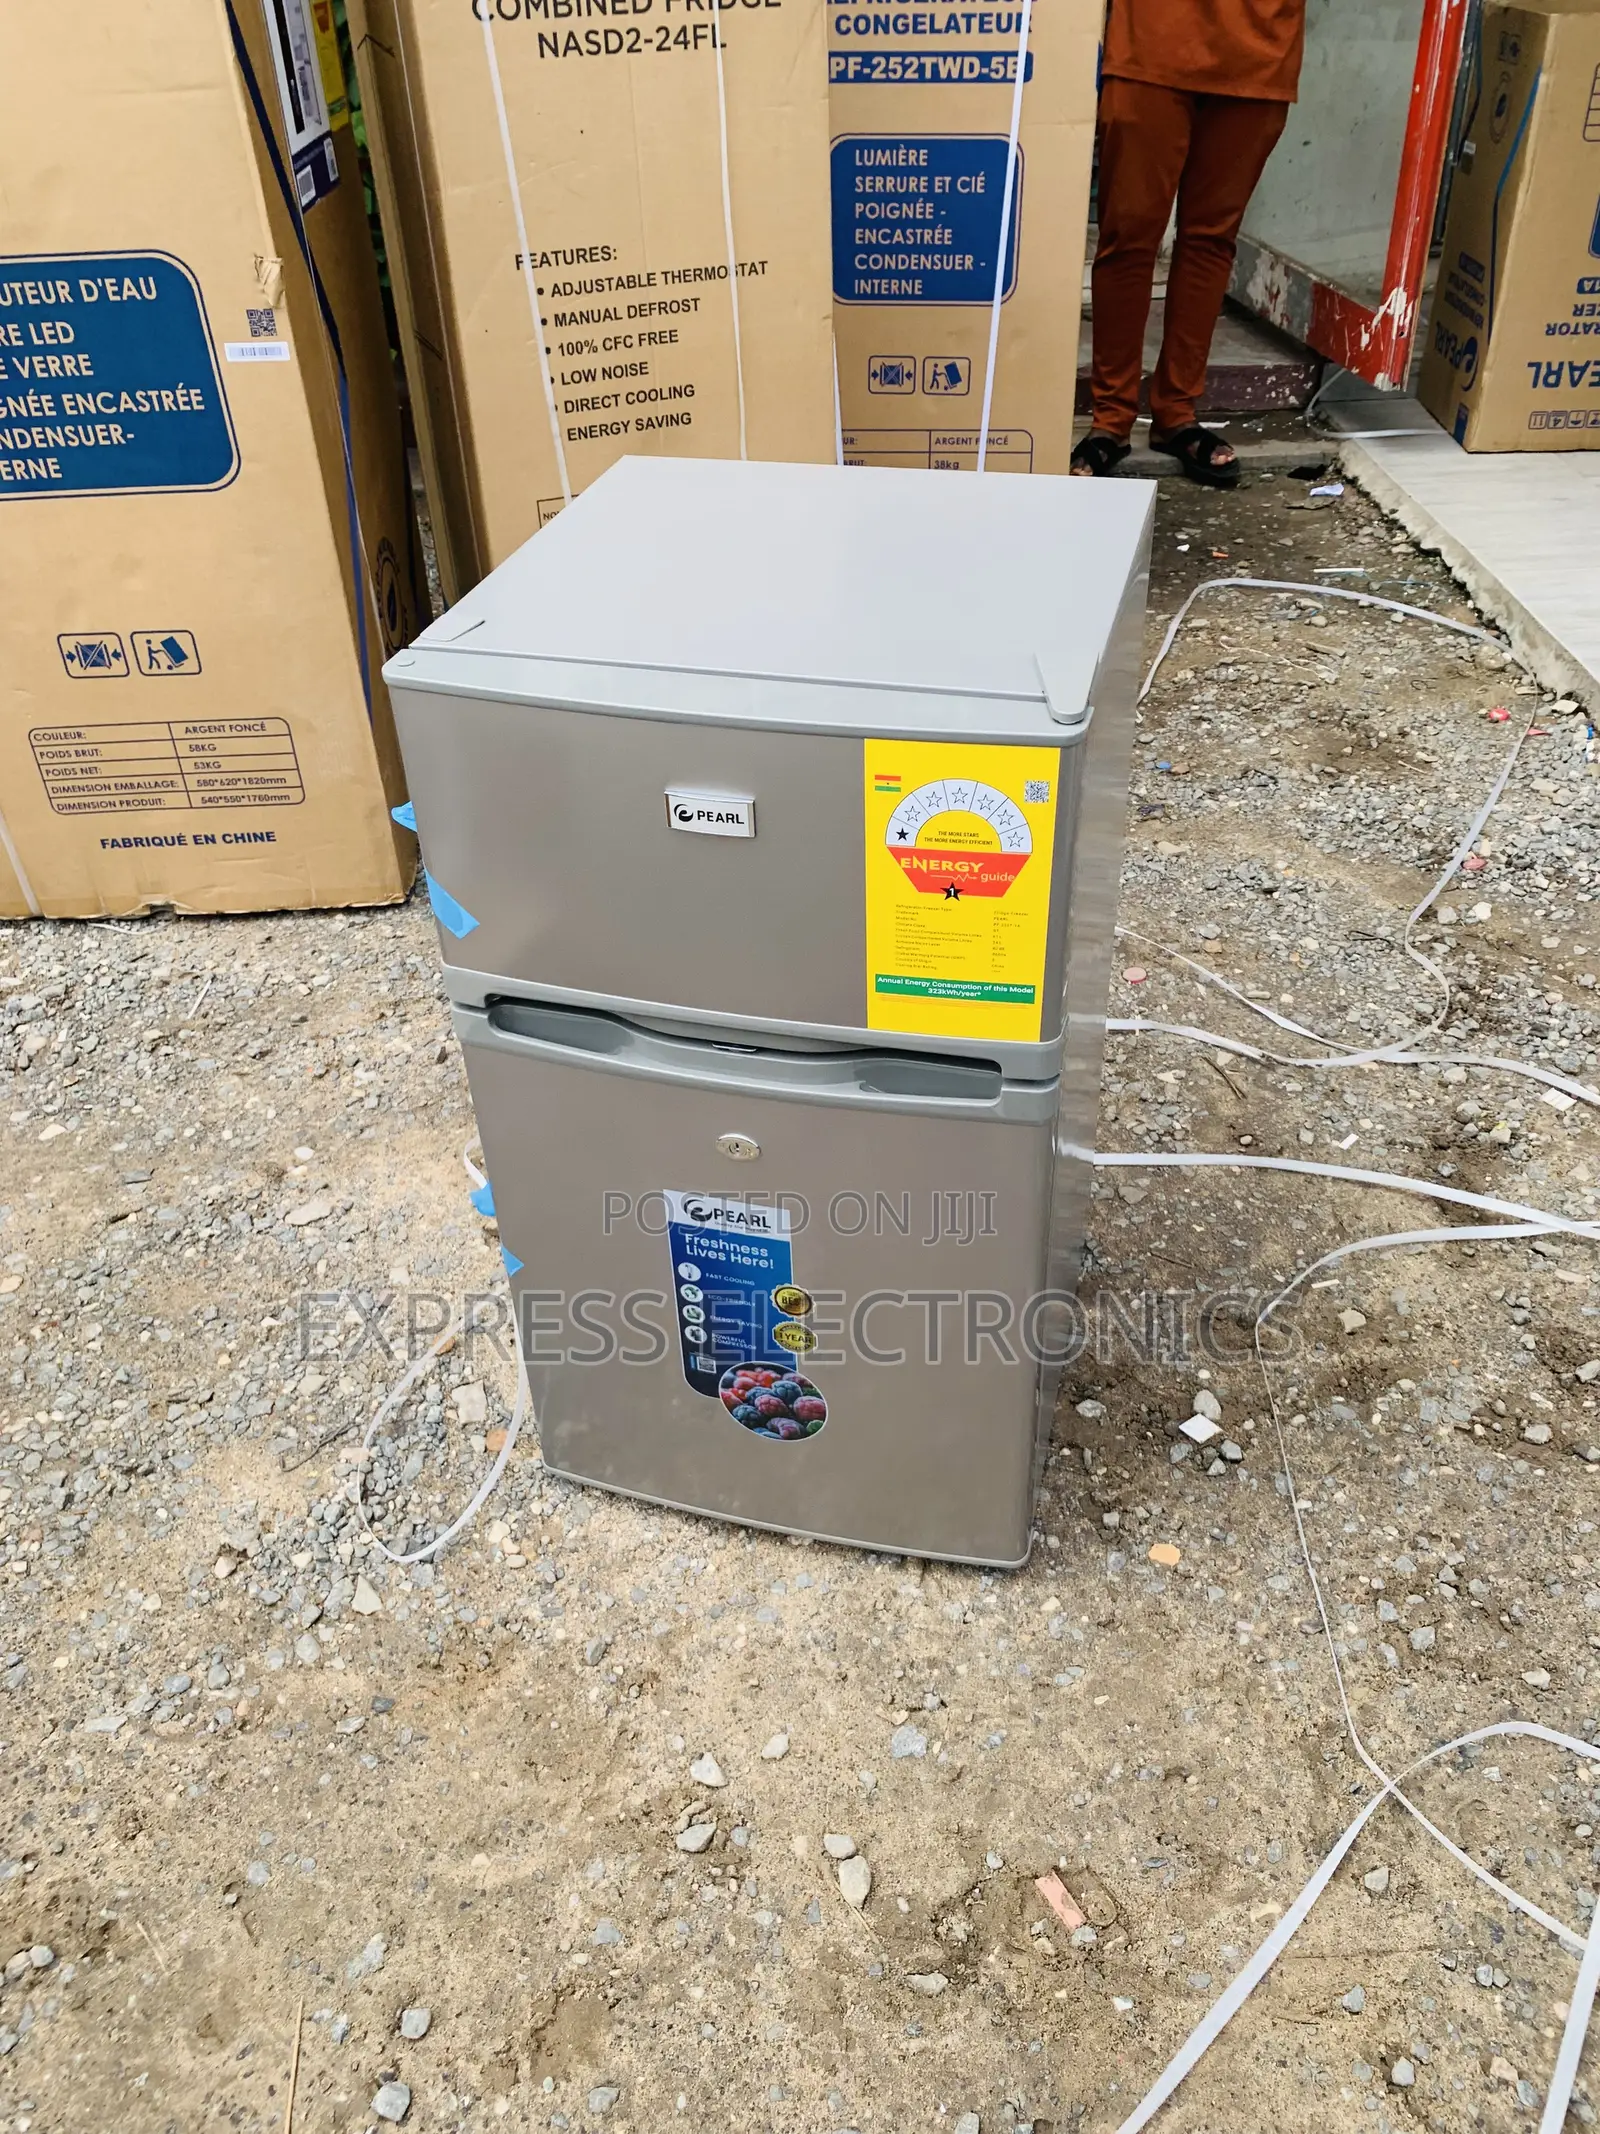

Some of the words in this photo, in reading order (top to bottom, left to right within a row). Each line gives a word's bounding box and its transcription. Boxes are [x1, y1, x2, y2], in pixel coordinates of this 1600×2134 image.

[538, 23, 727, 58] NASD2-24FL
[855, 144, 928, 166] LUMIÈRE
[855, 176, 928, 193] SERRURE
[934, 176, 951, 193] ET
[855, 197, 934, 219] POIGNÉE
[855, 224, 952, 245] ENCASTRÉE
[515, 245, 618, 271] FEATURES:
[854, 254, 973, 270] CONDENSUER
[79, 276, 157, 302] D'EAU
[551, 272, 657, 298] ADJUSTABLE
[855, 279, 922, 294] INTERNE
[554, 307, 623, 327] MANUAL
[627, 298, 700, 318] DEFROST
[1572, 304, 1600, 317] ER
[28, 321, 75, 345] LED
[558, 339, 598, 356] 100%
[603, 334, 634, 351] CFC
[638, 330, 679, 347] FREE
[12, 354, 94, 379] VERRE
[561, 369, 597, 386] LOW
[602, 362, 649, 381] NOISE
[62, 382, 205, 415] ENCASTRÉE
[564, 394, 621, 414] DIRECT
[625, 384, 695, 405] COOLING
[567, 420, 631, 442] ENERGY
[635, 412, 692, 431] SAVING
[935, 437, 972, 446] ARGENT
[976, 434, 1008, 446] FNCÉ
[33, 731, 87, 741] COULEUR:
[184, 724, 226, 735] ARGENT
[229, 721, 267, 732] FONCÉ
[39, 750, 72, 760] POIDS
[74, 748, 103, 758] BRUT:
[45, 767, 77, 777] POIDS
[80, 766, 102, 775] NET:
[194, 761, 222, 770] 53KG
[51, 783, 112, 794] DIMENSION
[114, 780, 179, 791] EMBALLAGE:
[57, 800, 117, 811] DIMENSION
[119, 798, 166, 808] PRODUIT:
[697, 810, 744, 824] PEARL
[100, 832, 188, 849] FABRIQUÉ
[193, 833, 217, 845] EN
[222, 831, 277, 845] CHINE
[900, 856, 984, 874] ENERGY
[981, 872, 1015, 883] guide
[949, 888, 955, 896] 1
[878, 976, 903, 985] Annual
[905, 979, 931, 988] Energy
[932, 981, 982, 991] Consumption
[1010, 986, 1033, 994] Model
[714, 1208, 771, 1228] PEARL
[685, 1233, 768, 1257] Freshness
[686, 1245, 726, 1261] Lives
[730, 1253, 774, 1269] Here!
[706, 1272, 722, 1280] FAST
[724, 1276, 755, 1286] COOLING
